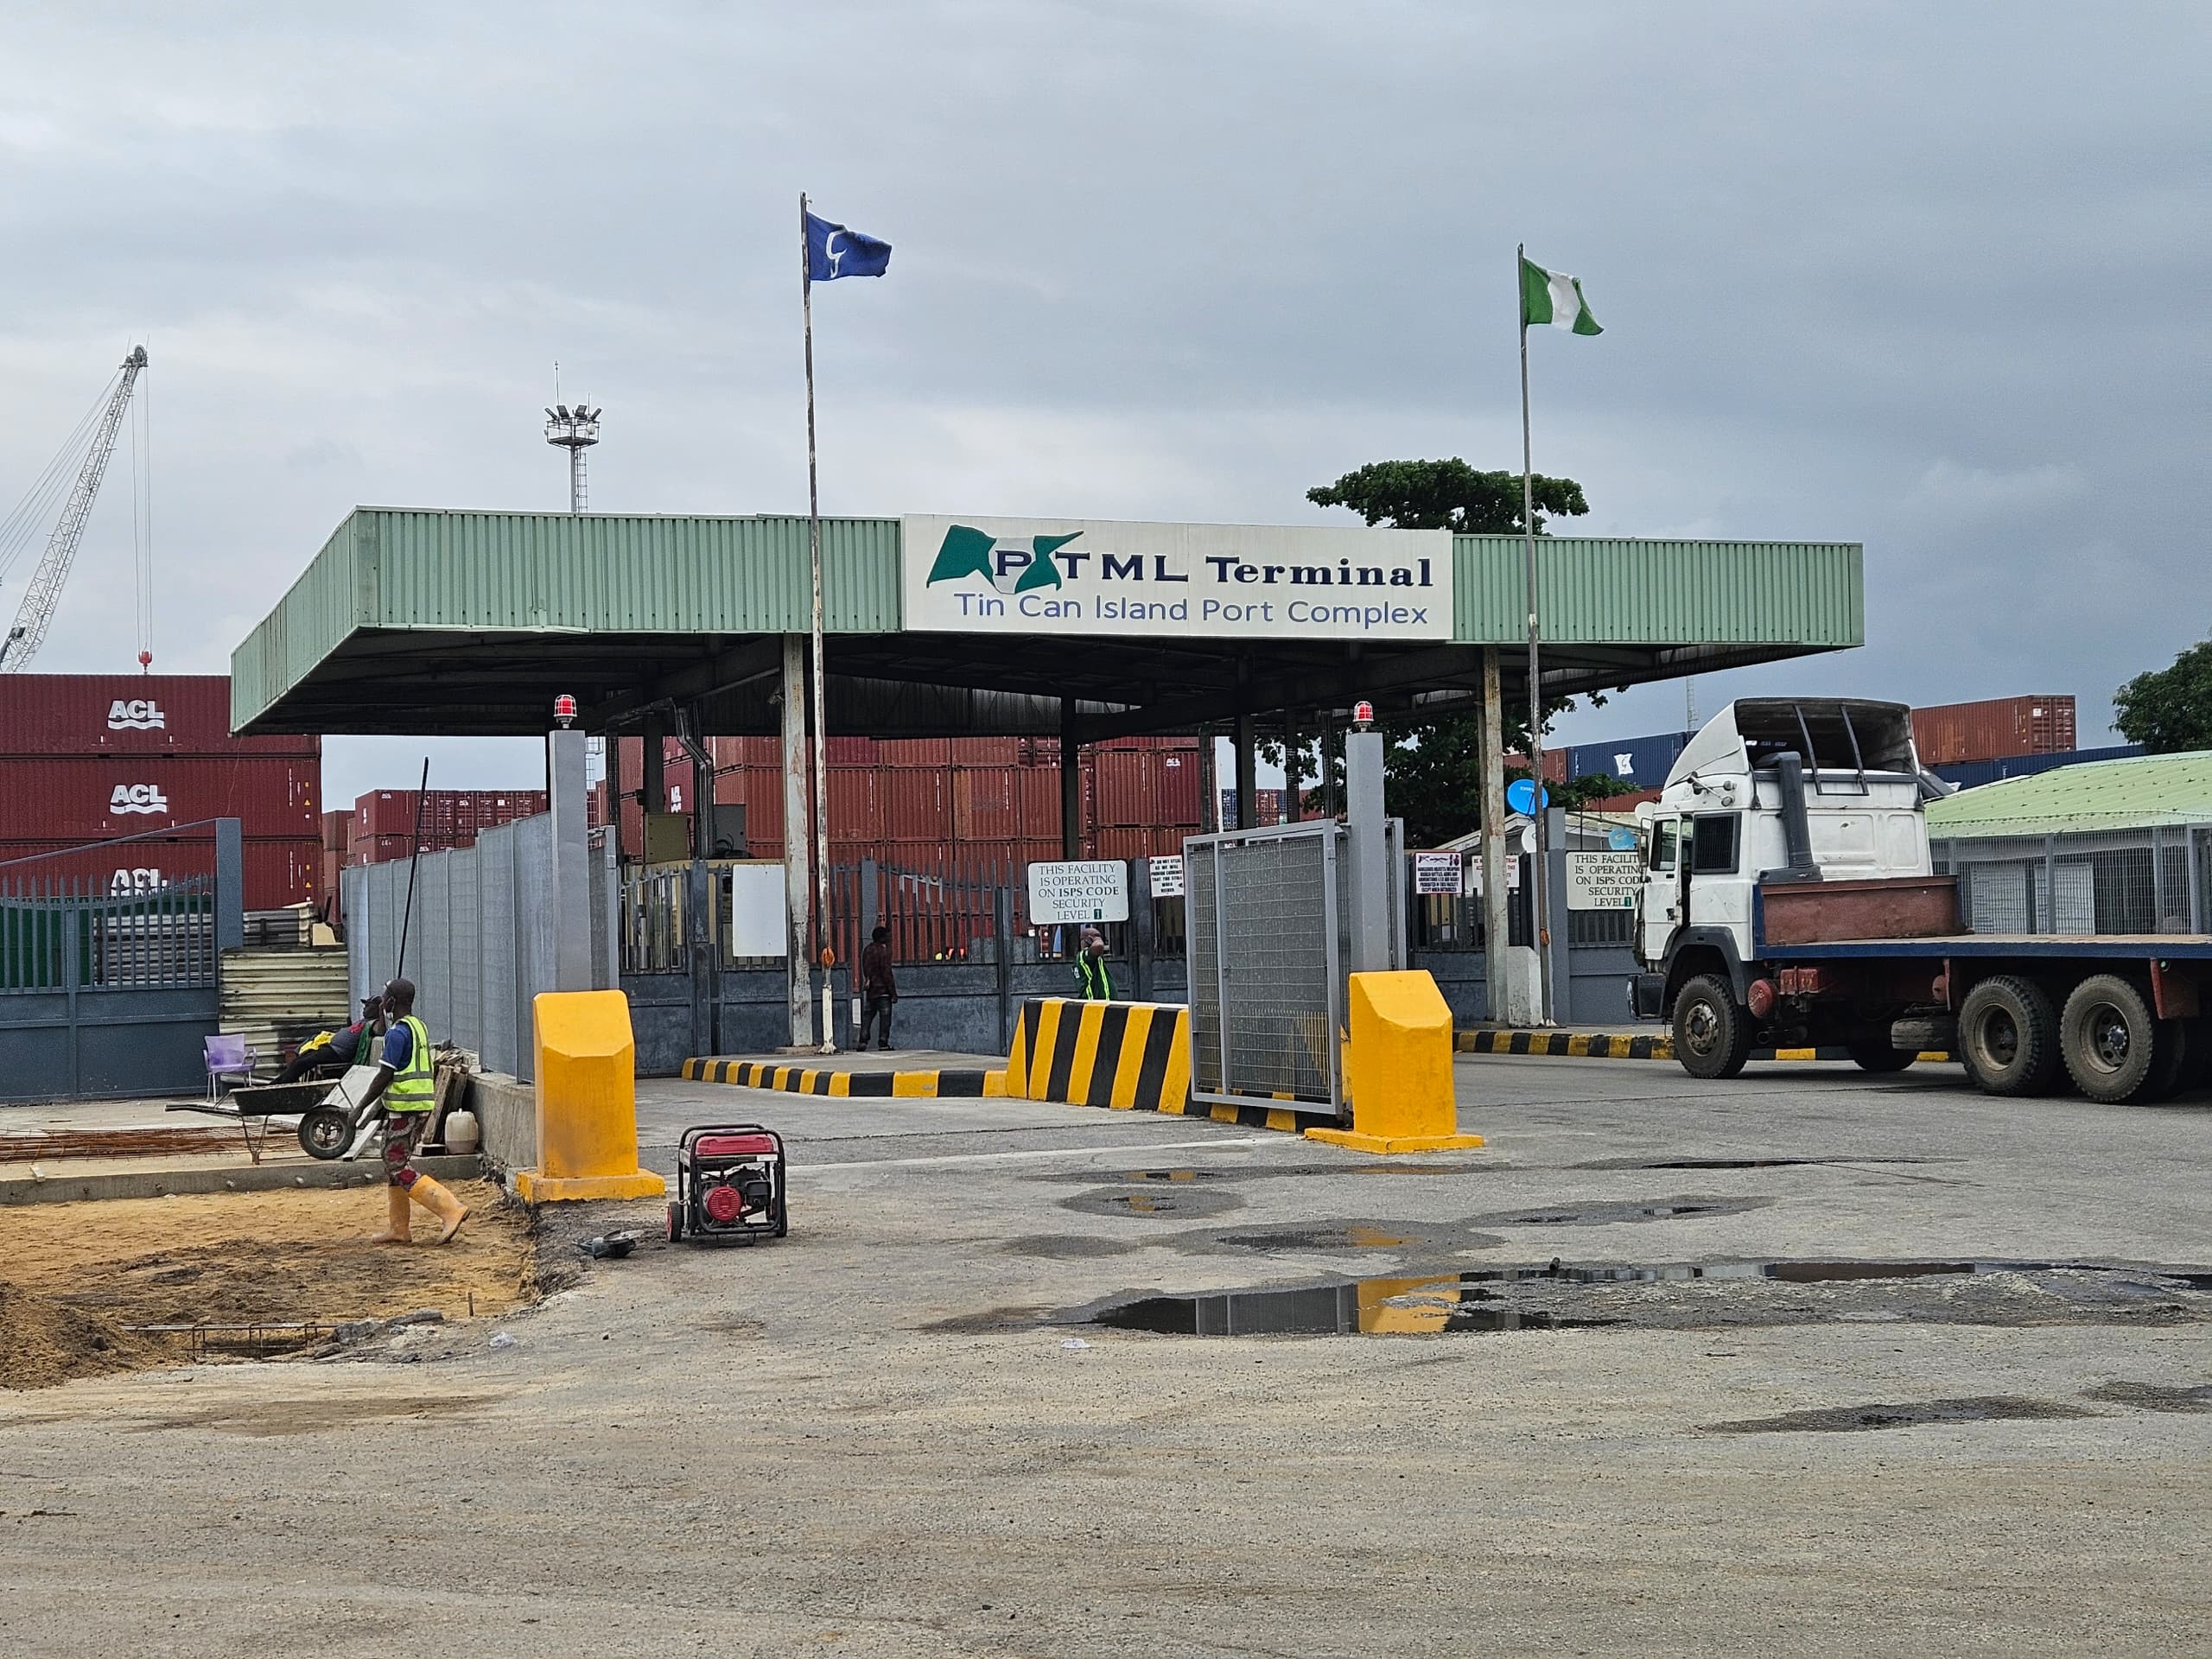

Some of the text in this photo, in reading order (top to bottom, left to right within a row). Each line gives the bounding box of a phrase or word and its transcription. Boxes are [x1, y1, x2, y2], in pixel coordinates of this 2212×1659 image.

[1205, 556, 1433, 587] Terminal
[953, 593, 1428, 629] Tin Can Island Port Complex
[108, 699, 164, 719] ACL
[111, 784, 167, 804] ACL
[1574, 855, 1639, 863] THIS FACILIT
[1039, 863, 1116, 874] THIS FACILITY
[1575, 865, 1584, 874] IS
[1040, 874, 1116, 886] IS OPERATING
[1575, 876, 1641, 885] ON ISPS COD
[1039, 887, 1119, 898] ON ISPS CODE
[1588, 887, 1638, 896] SECURITY
[1052, 898, 1106, 909] SECURITY
[1594, 898, 1624, 906] LEVEL
[1057, 910, 1090, 920] LEVEL
